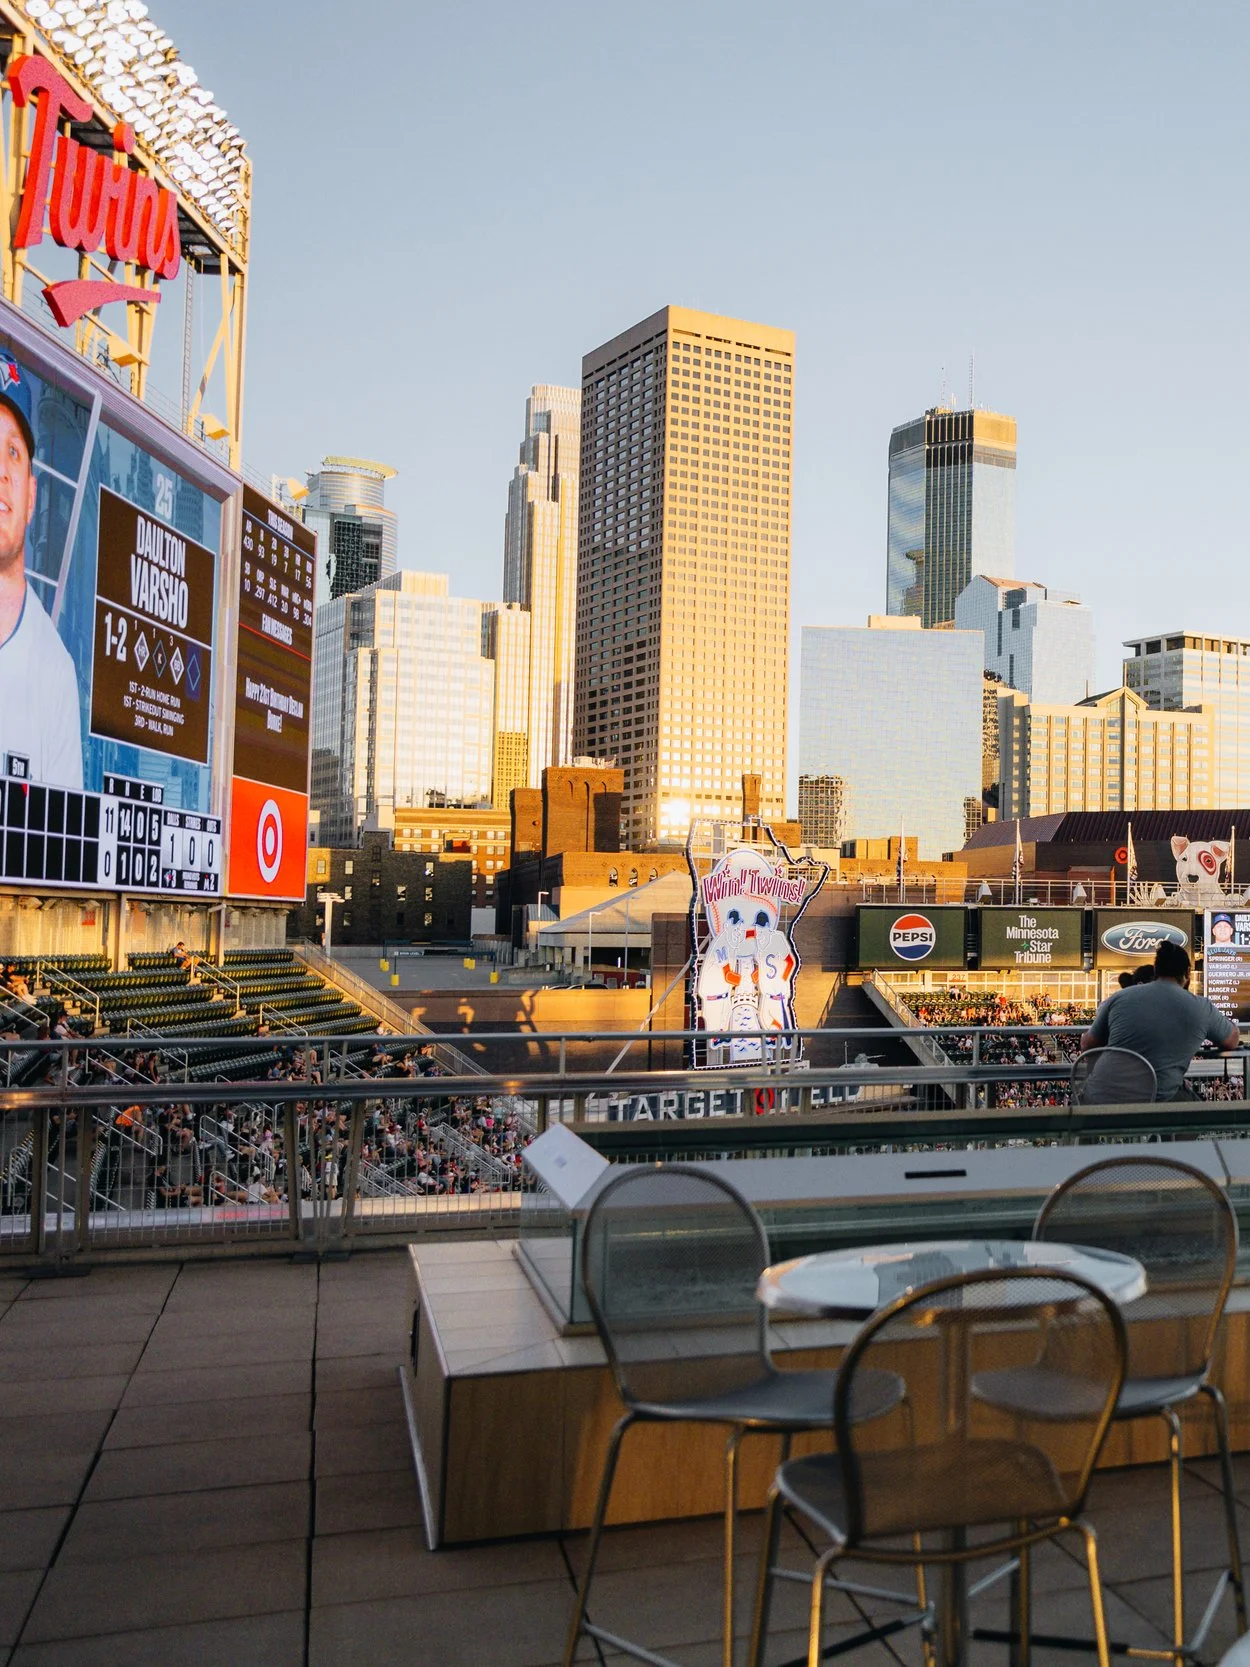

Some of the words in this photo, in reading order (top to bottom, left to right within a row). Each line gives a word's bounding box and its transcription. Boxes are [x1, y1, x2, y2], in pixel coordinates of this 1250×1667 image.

[8, 55, 181, 281] Twins
[155, 473, 173, 520] 25
[136, 514, 186, 578] DAULTON
[131, 553, 188, 629] VARSHO
[105, 612, 127, 662] 1-2
[12, 757, 25, 777] 5TH
[109, 778, 114, 793] R
[140, 784, 145, 799] E
[105, 807, 114, 834] 11
[120, 808, 131, 837] 14
[136, 811, 144, 839] 0
[152, 814, 159, 841] 5
[104, 850, 111, 877] 0
[121, 851, 126, 880] 1
[135, 853, 143, 881] 0
[150, 854, 157, 882] 2
[170, 833, 175, 863] 1
[189, 836, 195, 866] 0
[207, 839, 214, 868] 0
[703, 868, 747, 905] Win!
[749, 868, 806, 903] Twins!
[893, 932, 933, 943] PEPSI
[1006, 926, 1059, 939] Minnesota
[1019, 915, 1037, 928] The
[1029, 940, 1053, 952] Star
[1119, 927, 1171, 950] Ford
[765, 953, 777, 980] S
[1014, 951, 1052, 963] Tribune
[608, 1089, 744, 1121] TARGET
